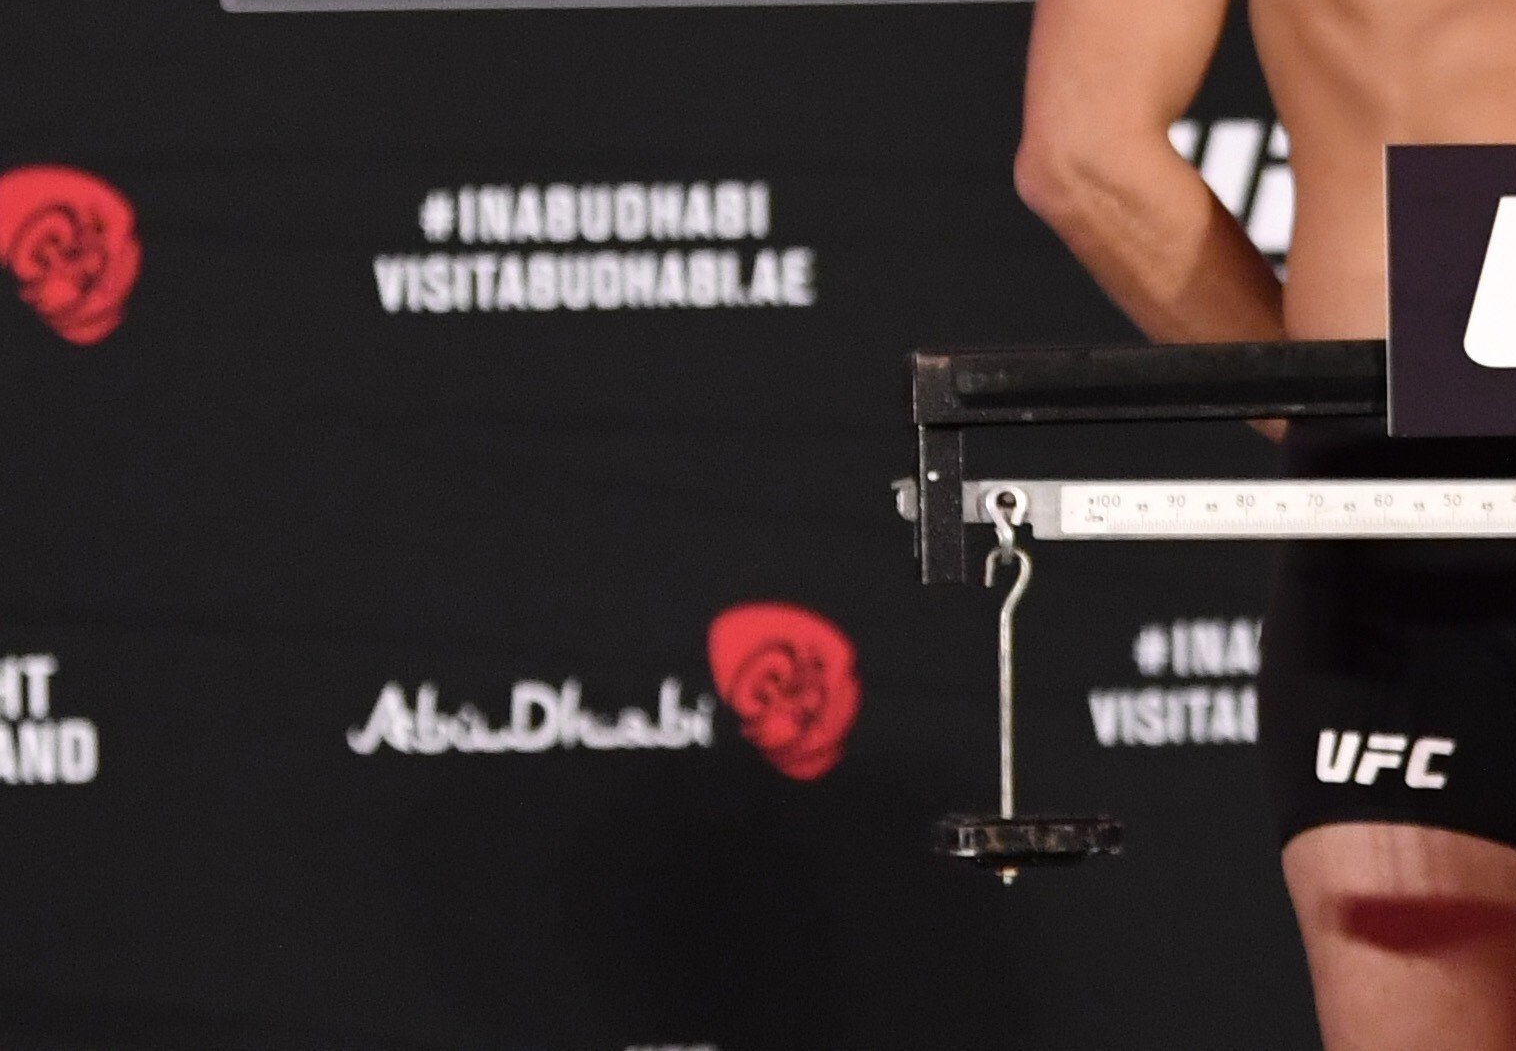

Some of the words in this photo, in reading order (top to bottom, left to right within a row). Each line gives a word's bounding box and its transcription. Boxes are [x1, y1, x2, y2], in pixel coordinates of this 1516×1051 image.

[419, 180, 769, 242] #INABUDHABI
[374, 248, 814, 313] VISITABUDHABI.AE
[1235, 494, 1255, 507] 80
[1307, 494, 1324, 507] 70
[1374, 493, 1393, 507] 60
[1443, 493, 1462, 506] 50
[1133, 619, 1260, 677] #INA
[1316, 729, 1456, 790] UFC
